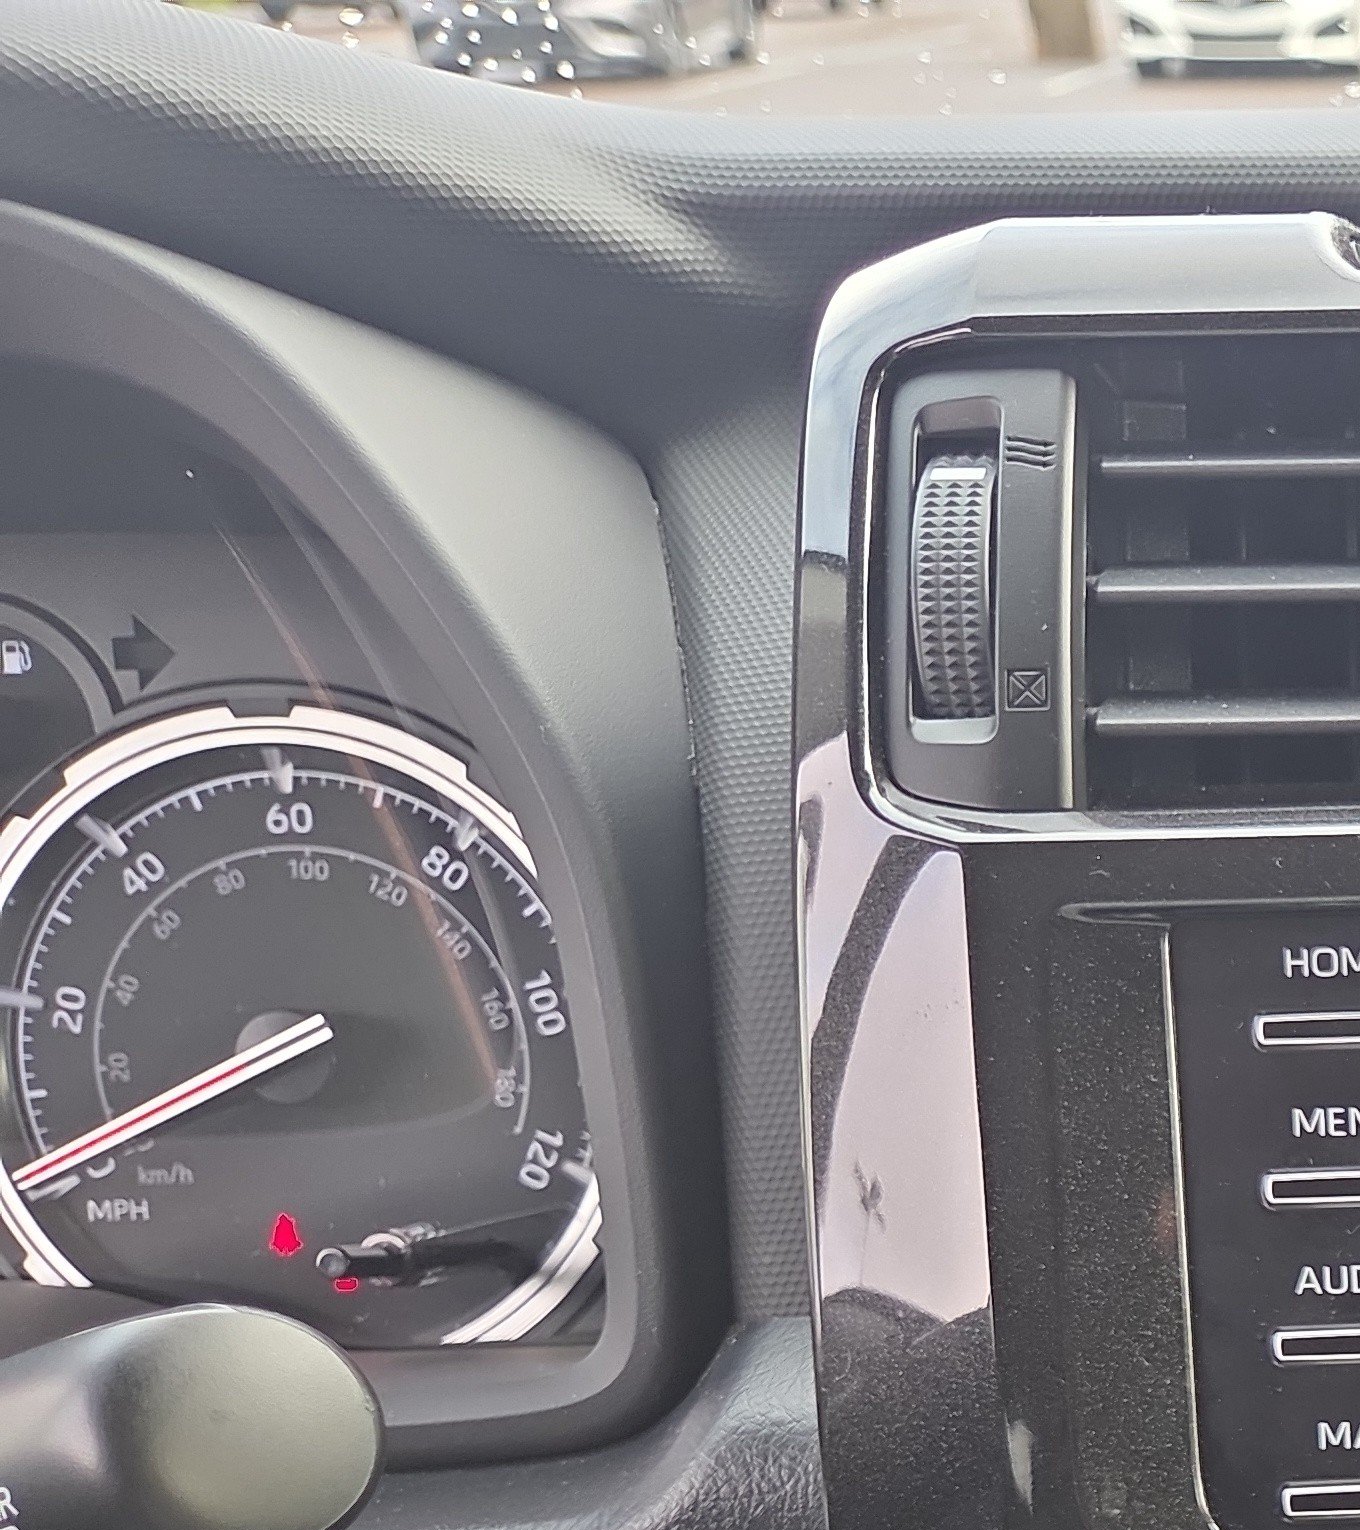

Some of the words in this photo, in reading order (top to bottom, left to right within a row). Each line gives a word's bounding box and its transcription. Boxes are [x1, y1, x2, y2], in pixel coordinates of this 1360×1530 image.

[265, 801, 314, 835] 60
[121, 852, 166, 896] 40
[214, 868, 246, 897] 80
[286, 856, 330, 882] 100
[420, 845, 469, 892] 80
[366, 873, 409, 907] 120
[151, 908, 182, 941] 60
[115, 974, 140, 1006] 40
[522, 970, 566, 1036] 100
[52, 986, 86, 1036] 20
[482, 988, 508, 1031] 160
[108, 1053, 130, 1083] 20
[518, 1129, 564, 1190] 120
[86, 1198, 150, 1223] MPH
